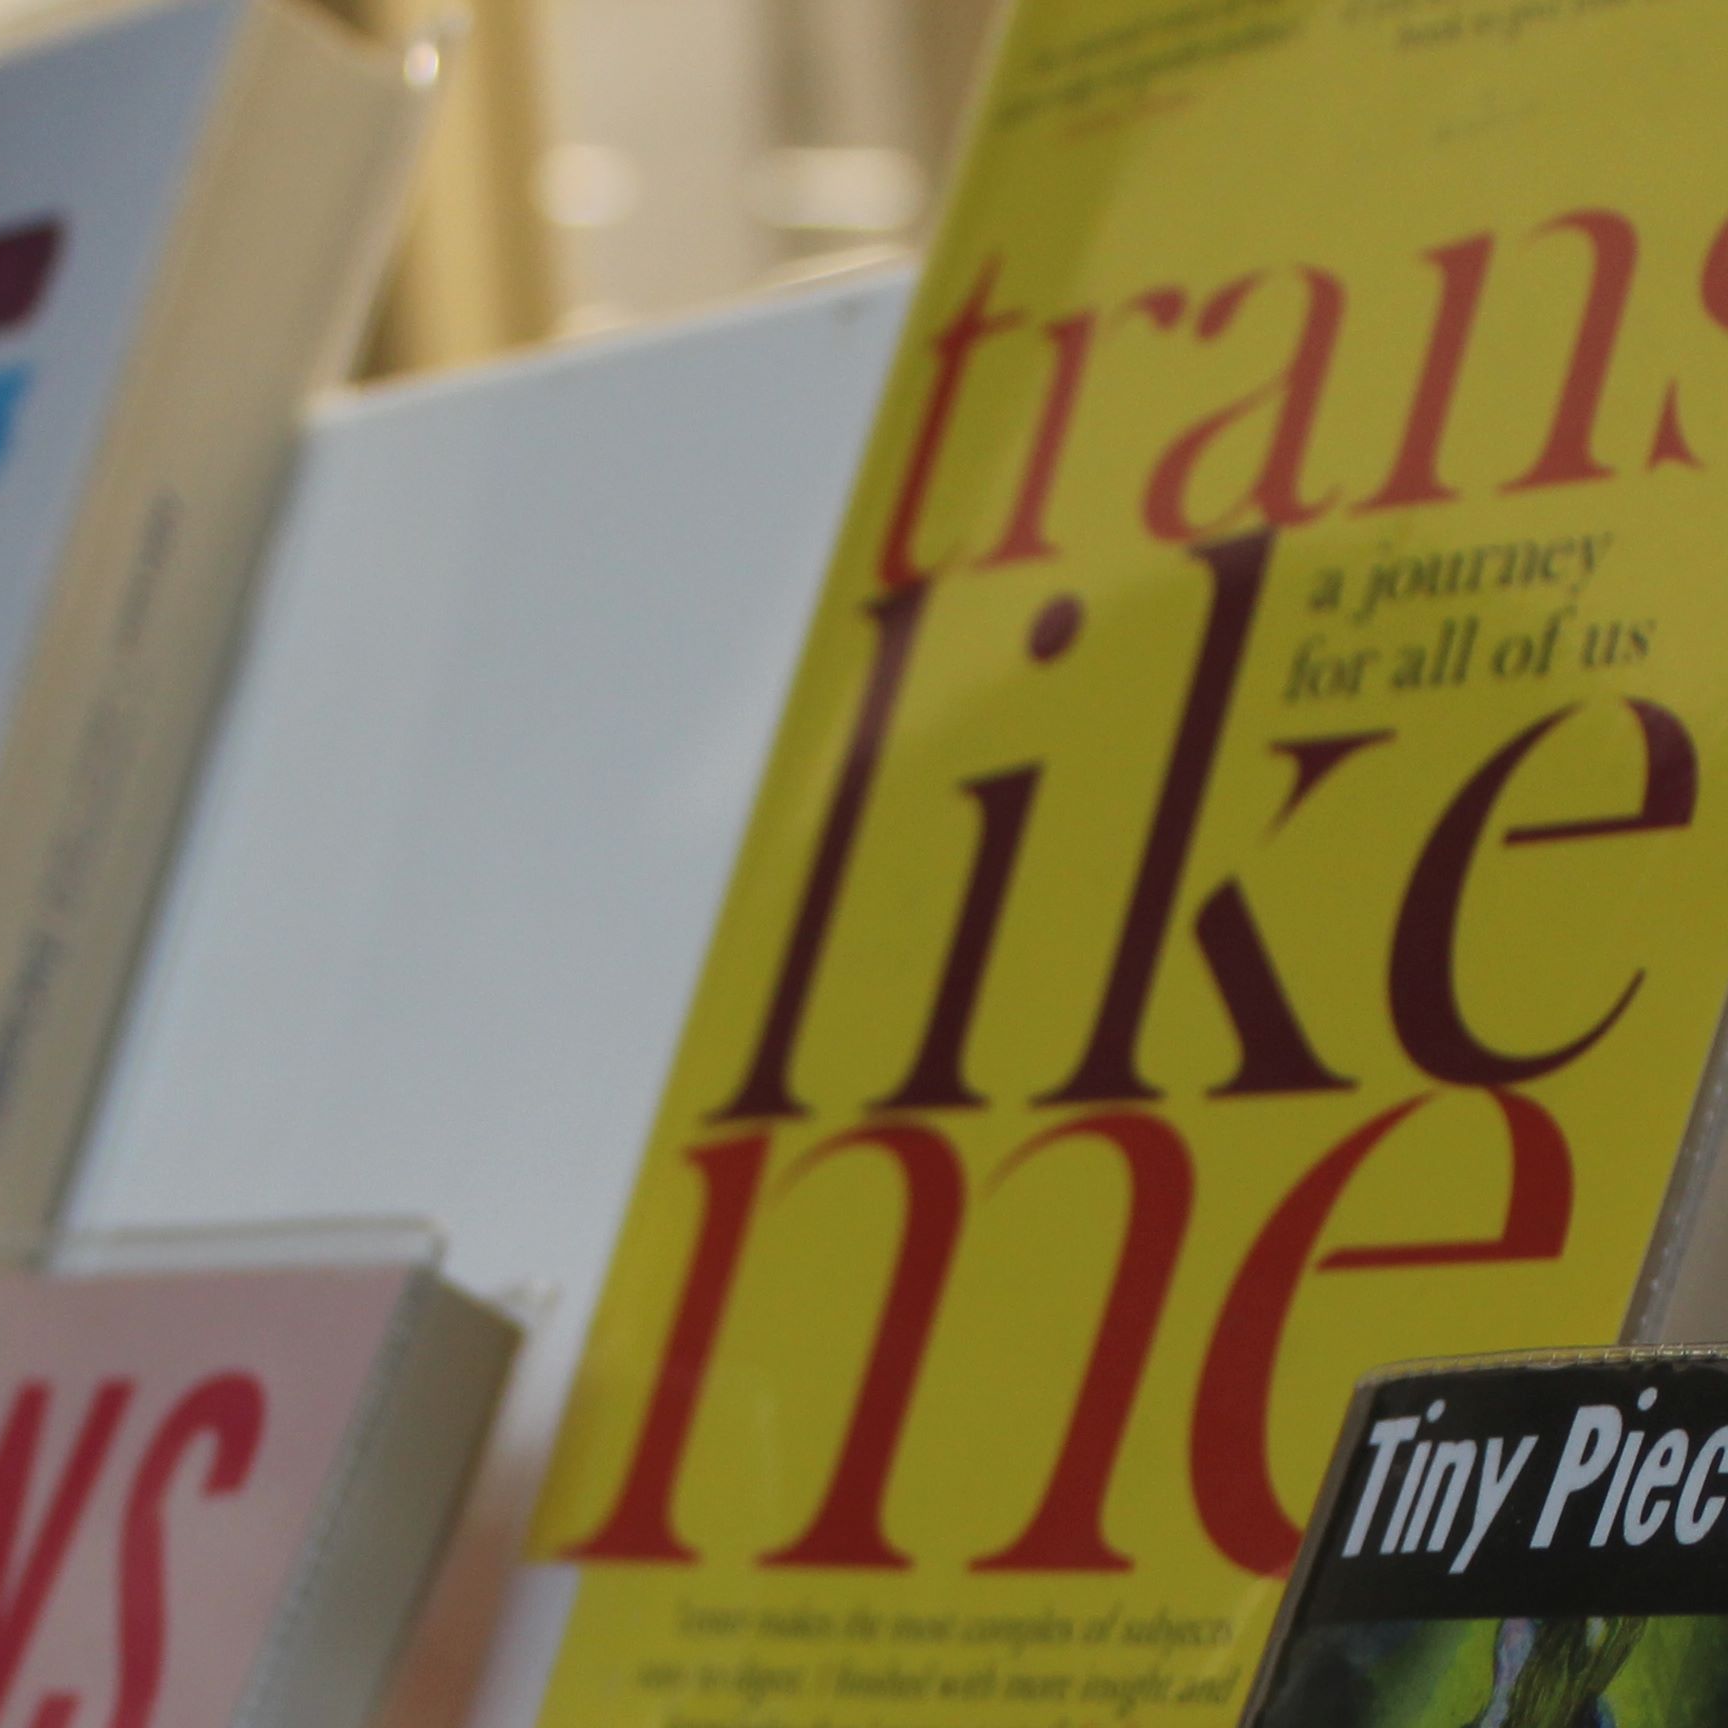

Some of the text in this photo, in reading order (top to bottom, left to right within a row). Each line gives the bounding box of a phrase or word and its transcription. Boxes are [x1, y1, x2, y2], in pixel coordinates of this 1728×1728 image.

[1283, 603, 1658, 705] for all of us
[1306, 530, 1614, 628] a journey
[700, 528, 1699, 1126] like
[562, 1088, 1576, 1581] me
[1342, 1400, 1538, 1574] Tiny
